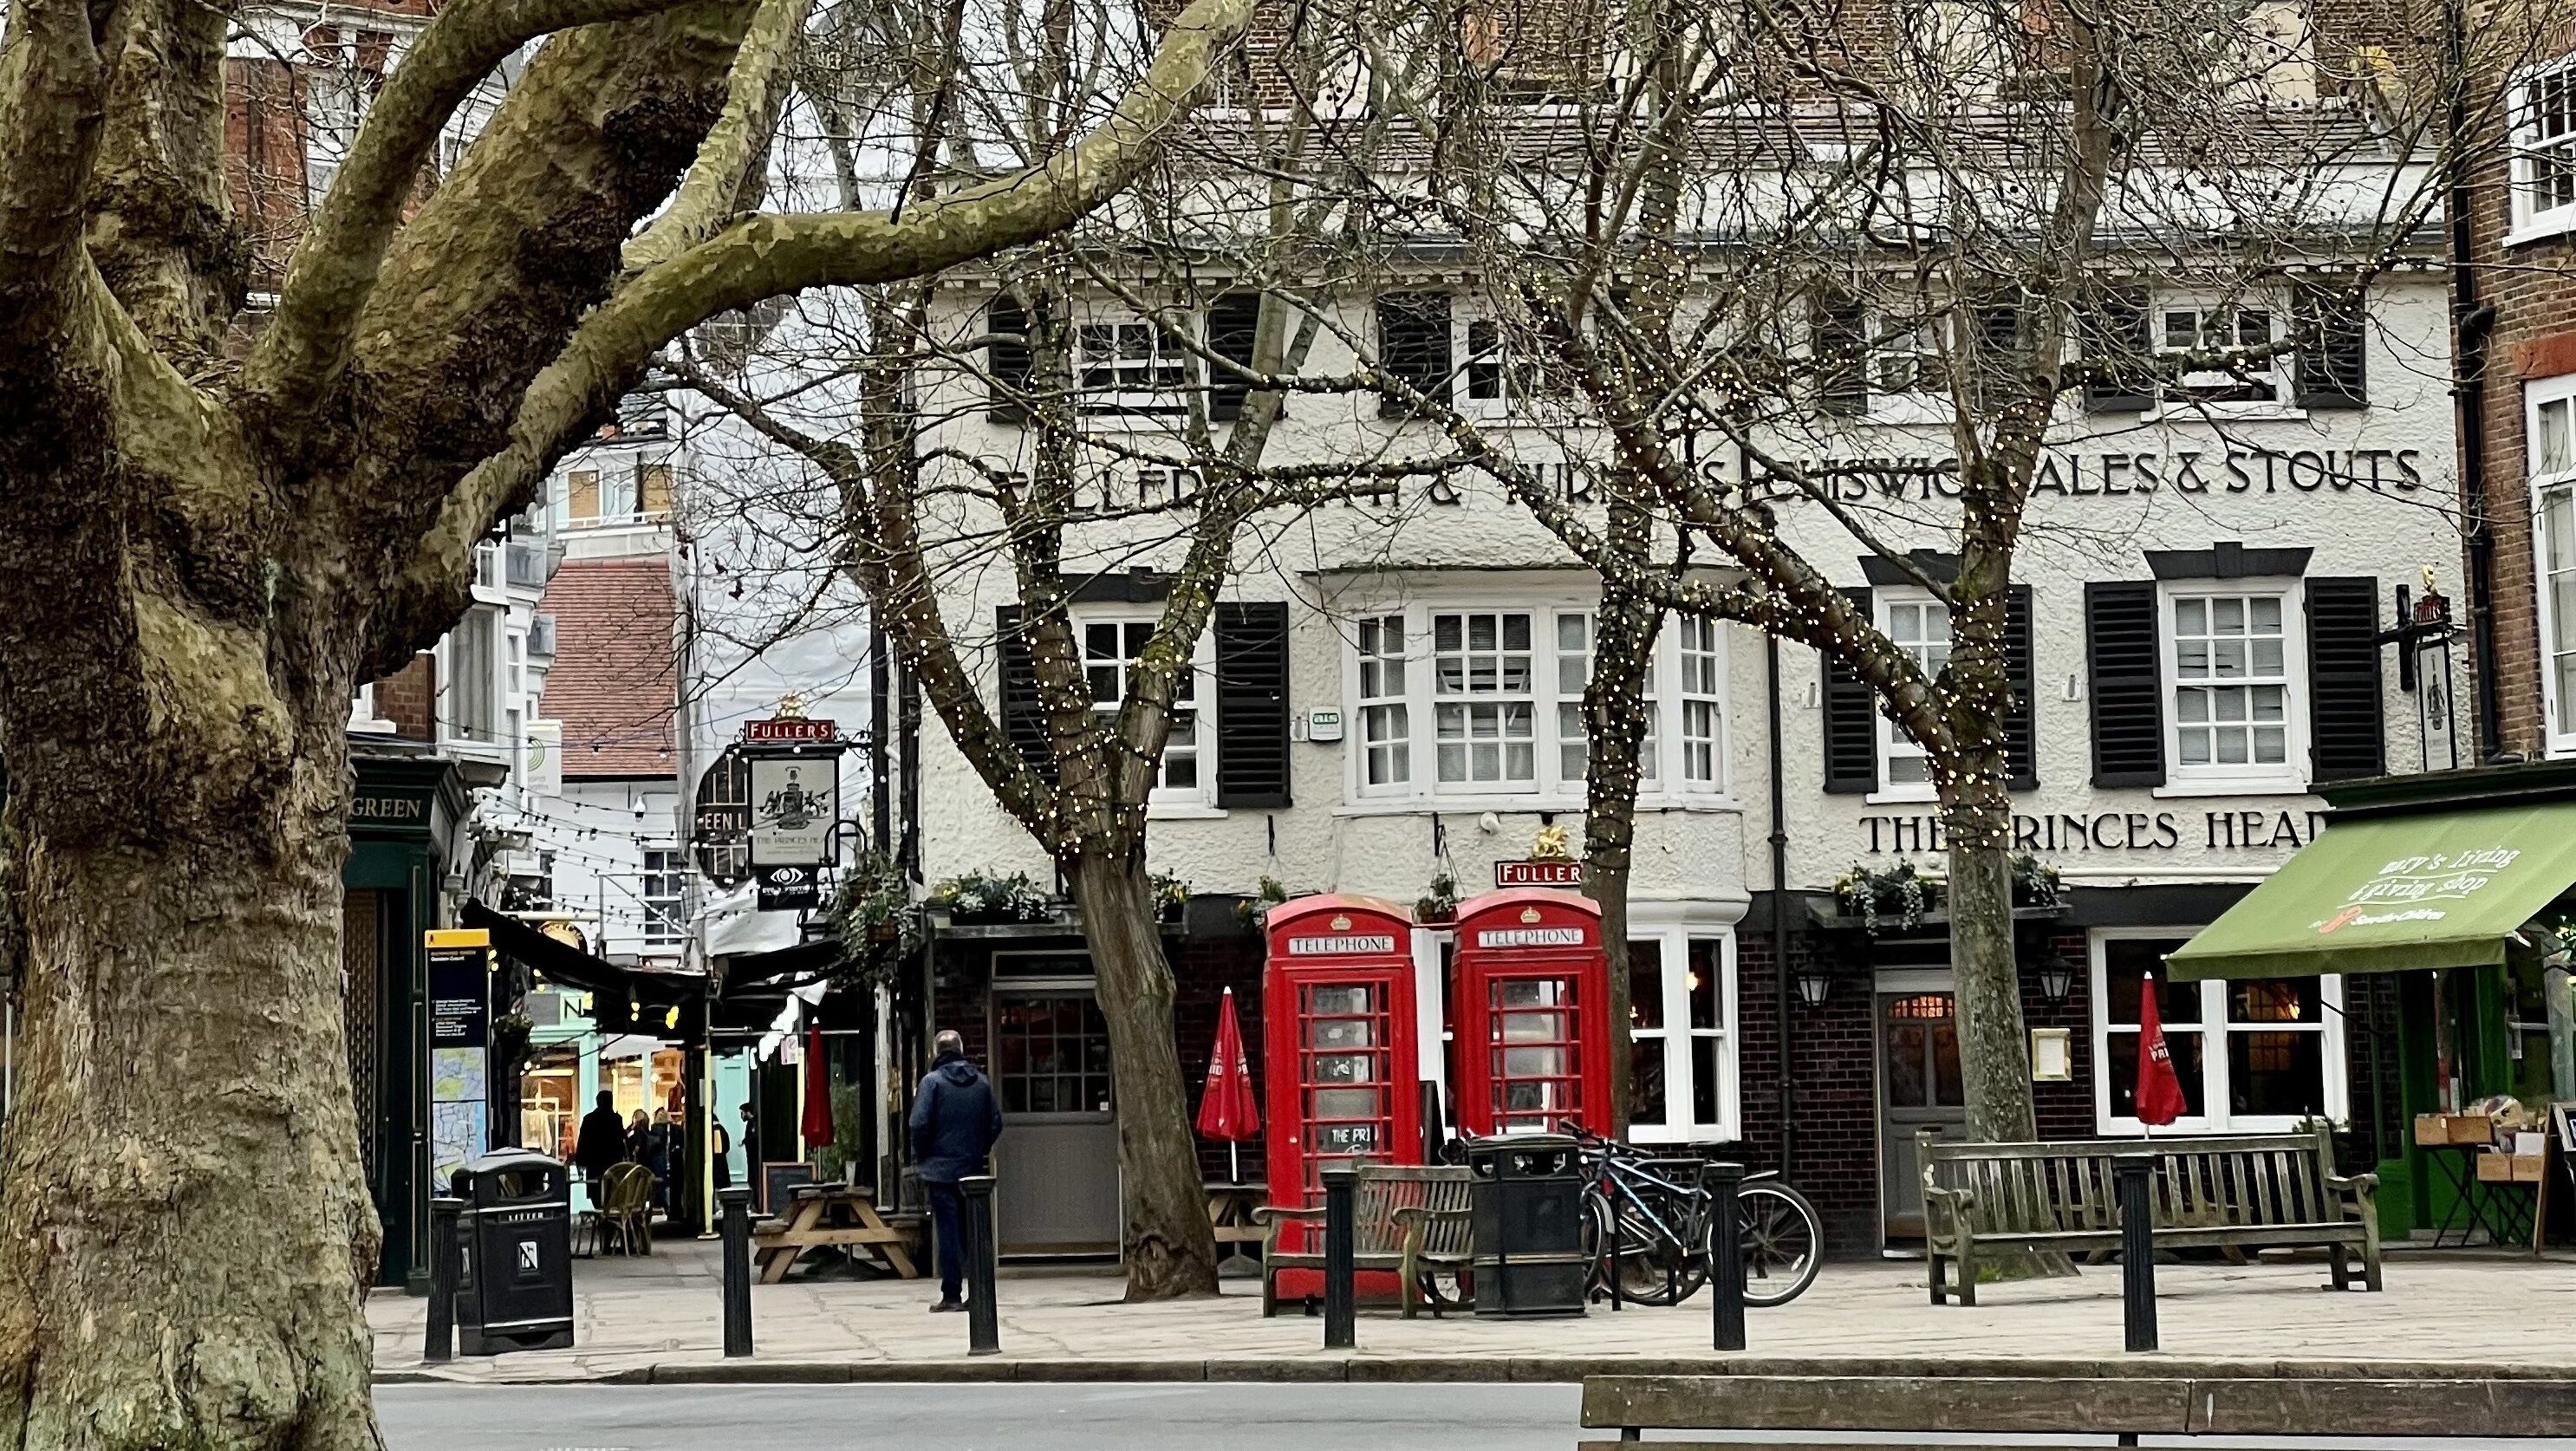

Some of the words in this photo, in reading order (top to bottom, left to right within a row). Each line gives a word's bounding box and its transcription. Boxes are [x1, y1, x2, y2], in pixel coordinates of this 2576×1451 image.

[2029, 452, 2157, 498] ALES
[2176, 451, 2210, 494] &
[2224, 449, 2421, 493] STOUTS
[351, 797, 421, 818] GREEN
[2012, 812, 2178, 850] RINCES
[1503, 864, 1583, 882] FULLER
[2436, 872, 2489, 895] shop
[1294, 937, 1392, 953] TELEPHONE
[1485, 929, 1581, 945] TELEPHONE
[1331, 1129, 1350, 1143] THE
